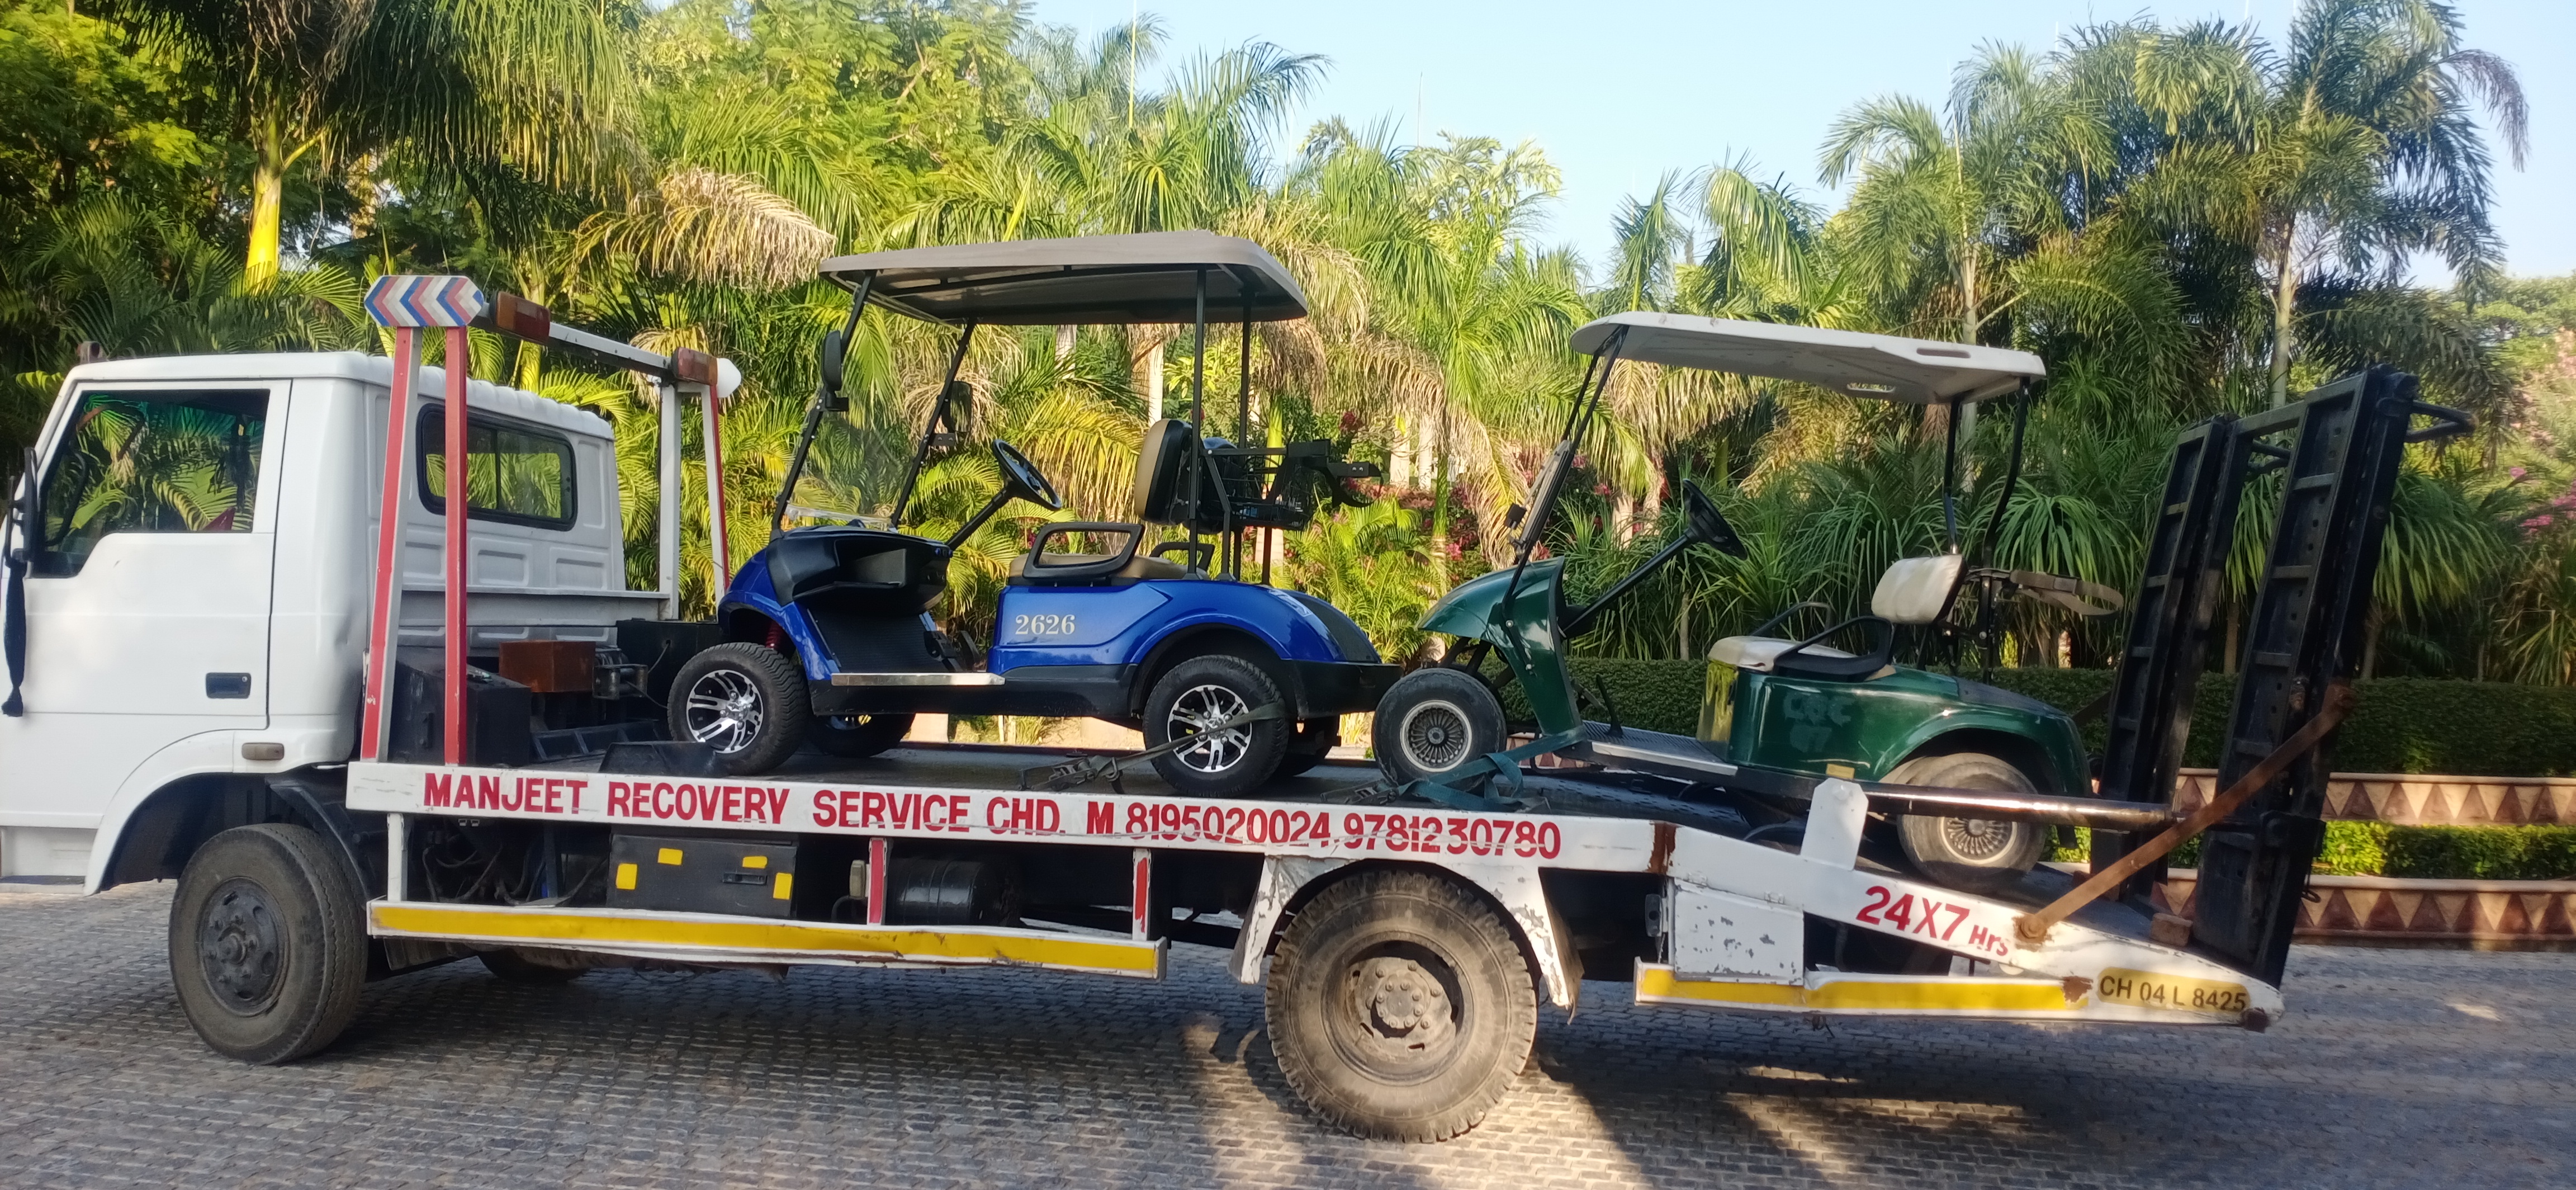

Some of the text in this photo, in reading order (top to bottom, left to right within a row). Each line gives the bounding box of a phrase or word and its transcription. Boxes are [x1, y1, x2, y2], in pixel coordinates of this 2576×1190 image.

[1015, 614, 1076, 635] 2626
[424, 773, 588, 814] MANJEET
[608, 782, 790, 824] RECOVERY
[813, 790, 971, 833] SERVICE
[986, 796, 1066, 836] CHD.
[1855, 885, 1970, 942] 24X7
[2099, 975, 2247, 1012] CH 04 L 8425
